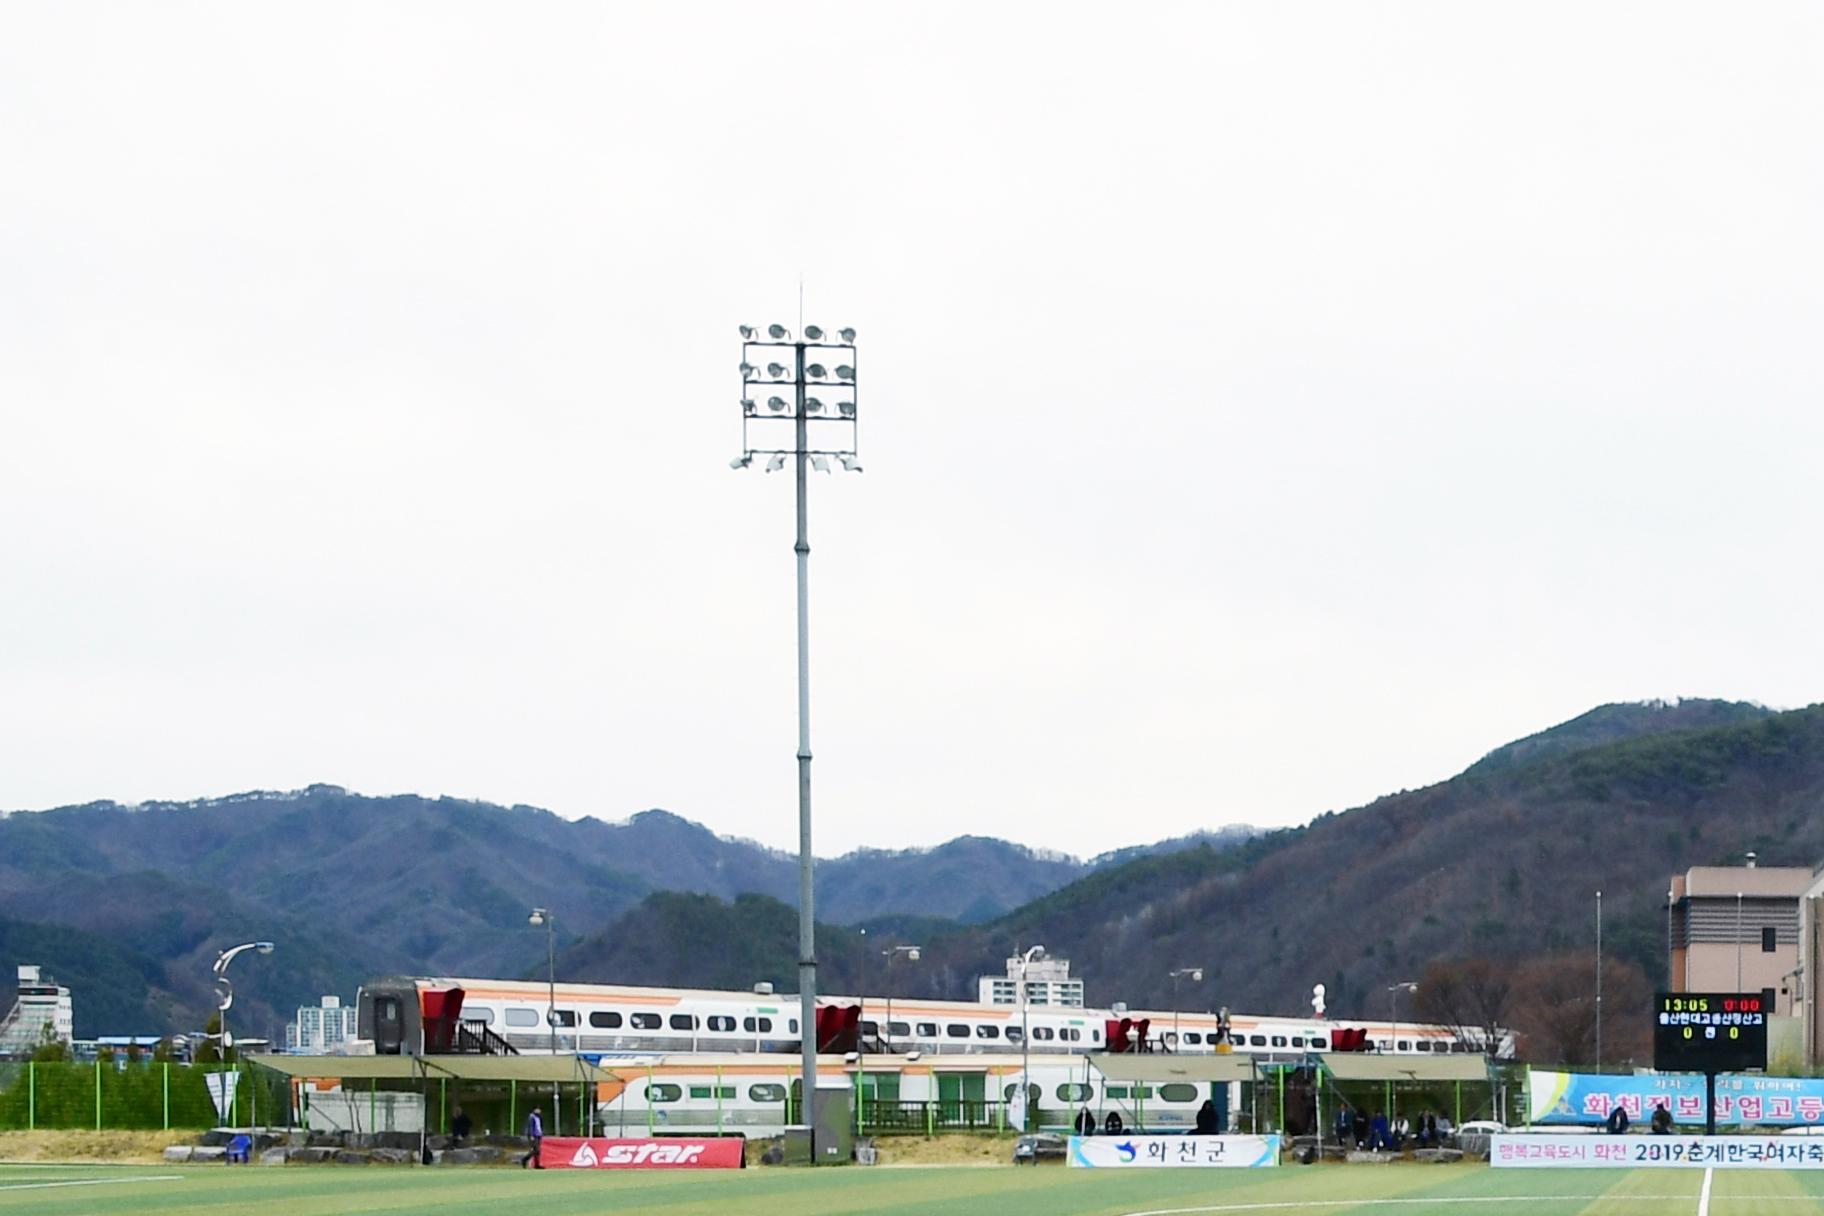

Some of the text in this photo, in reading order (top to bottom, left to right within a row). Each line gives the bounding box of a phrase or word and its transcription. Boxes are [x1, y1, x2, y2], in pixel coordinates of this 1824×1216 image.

[1665, 999, 1760, 1011] 13:05 0:00
[1683, 1026, 1693, 1039] 0
[1729, 1026, 1739, 1039] 0
[1147, 1141, 1226, 1163] 화천군
[1594, 1144, 1627, 1161] 화천
